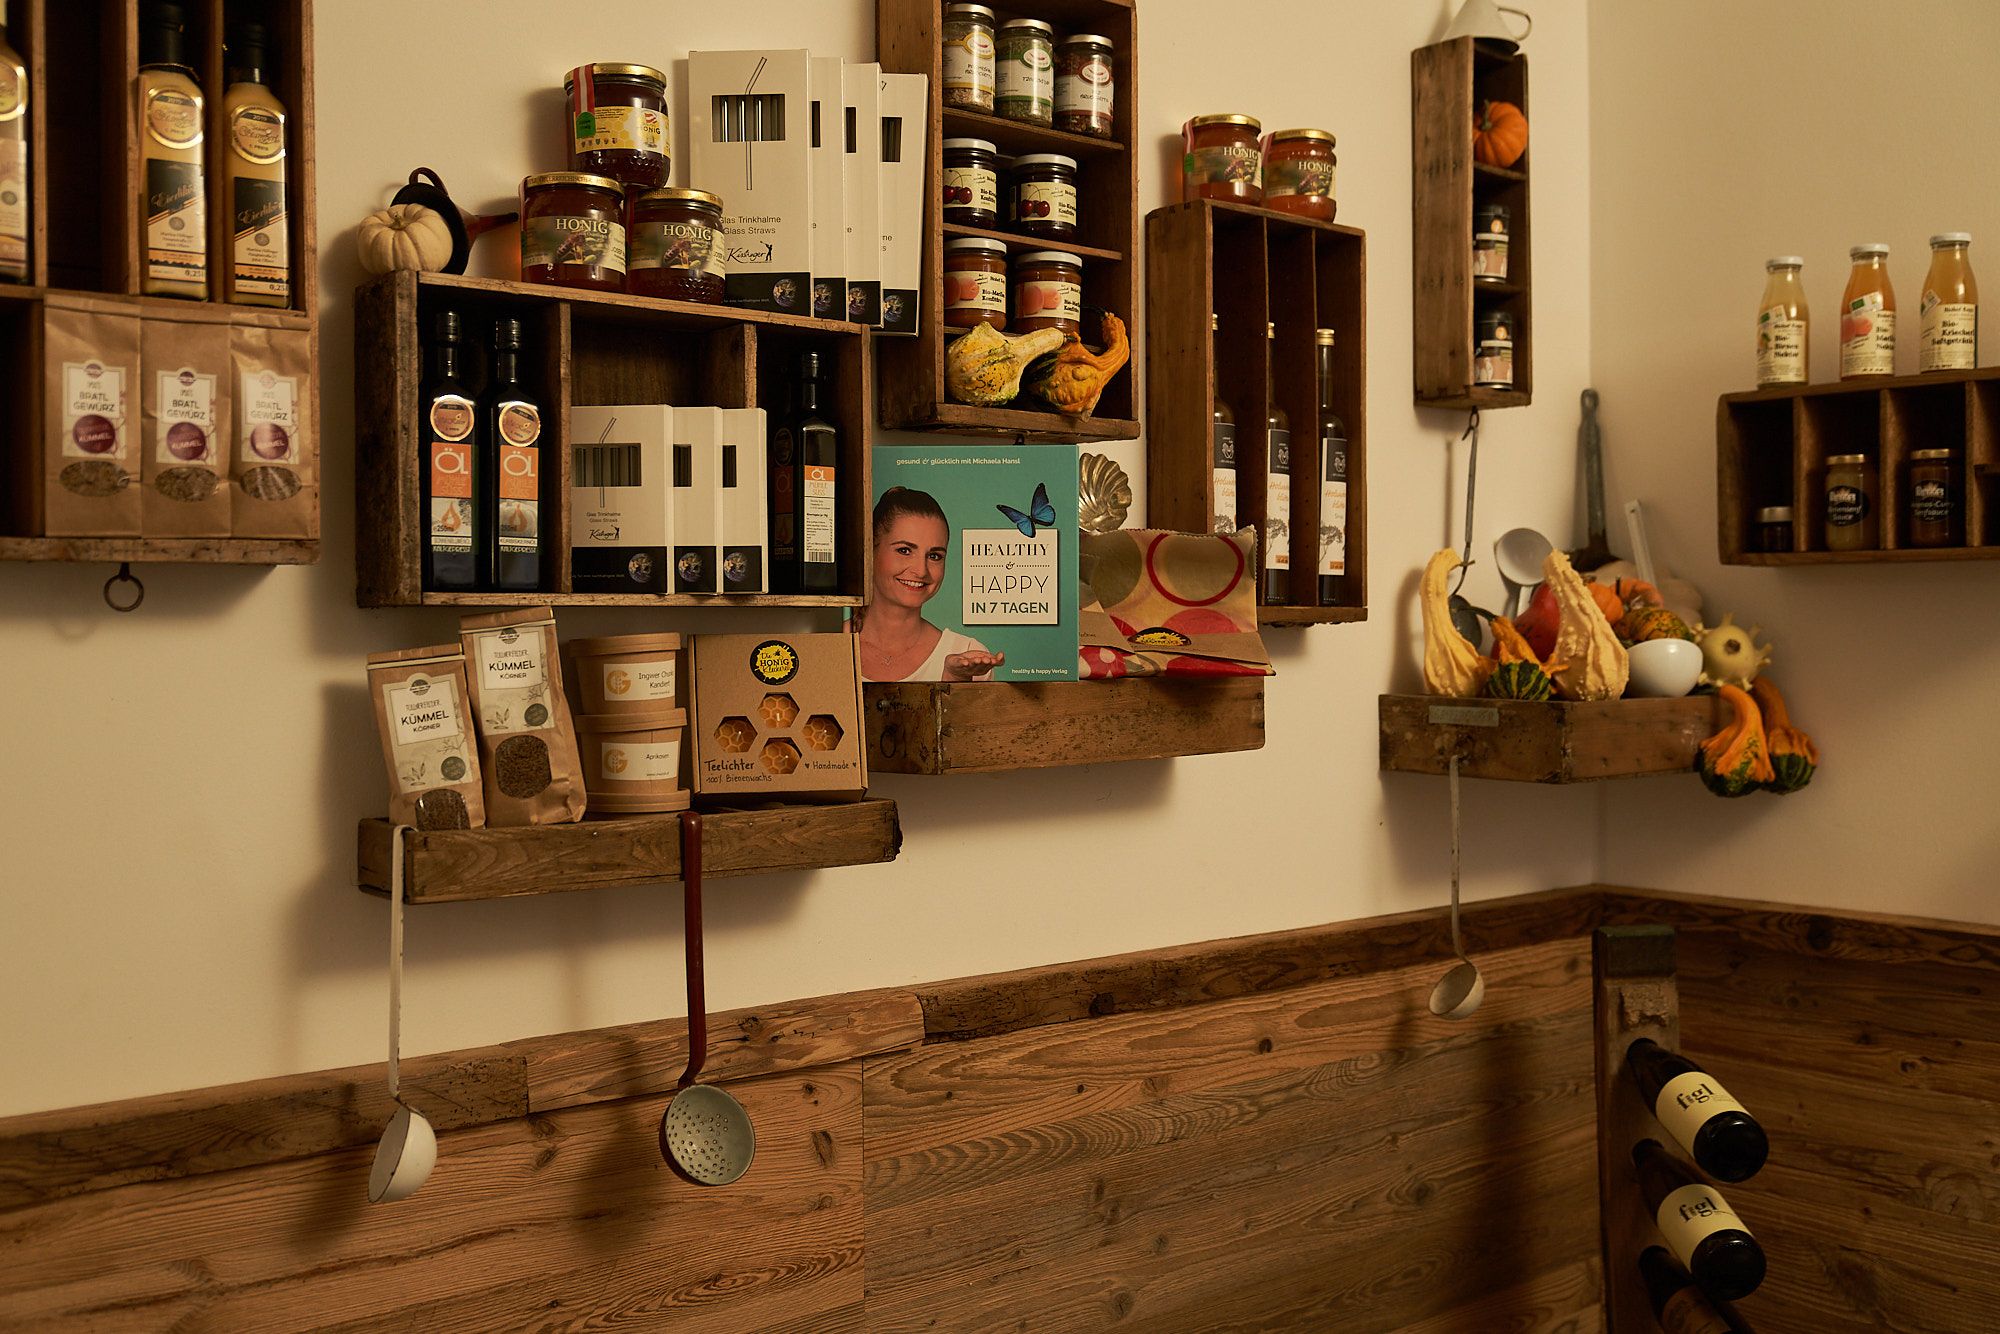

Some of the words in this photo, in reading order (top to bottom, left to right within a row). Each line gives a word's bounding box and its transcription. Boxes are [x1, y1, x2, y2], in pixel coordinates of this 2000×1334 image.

[1223, 147, 1259, 160] HONIG
[1298, 161, 1332, 174] HONIG
[556, 218, 608, 234] HONIG
[720, 216, 736, 224] Glas
[738, 216, 782, 224] Trinkhalme
[663, 224, 712, 241] HONIG
[723, 227, 746, 235] Glass
[748, 226, 776, 235] Straws
[80, 391, 109, 402] BRATL
[73, 401, 116, 413] GEWÜRZ
[172, 399, 200, 410] BRATL
[255, 400, 282, 411] BRATL
[166, 409, 206, 421] GEWÜRZ
[250, 410, 288, 422] GEWÜRZ
[435, 447, 469, 475] ÖL
[504, 450, 536, 477] ÖL
[896, 458, 921, 467] gesund
[930, 457, 960, 467] glücklich
[961, 457, 972, 465] mit
[973, 457, 1002, 465] Michaela
[1002, 457, 1021, 465] Hansl
[970, 543, 1049, 556] HEALTHY
[1005, 561, 1015, 570] &
[970, 575, 1049, 594] HAPPY
[971, 602, 986, 614] IN
[990, 602, 997, 614] 7
[1002, 602, 1049, 614] TAGEN
[488, 659, 536, 671] KÜMMEL
[760, 658, 790, 667] HONIG
[500, 672, 527, 680] KÖRNER
[638, 672, 660, 681] Ingwer
[400, 710, 450, 726] KÜMMEL
[413, 722, 440, 732] KÖRNER
[704, 758, 755, 772] Teelichter
[812, 760, 850, 770] Handmade
[726, 772, 773, 783] Bienenwachs
